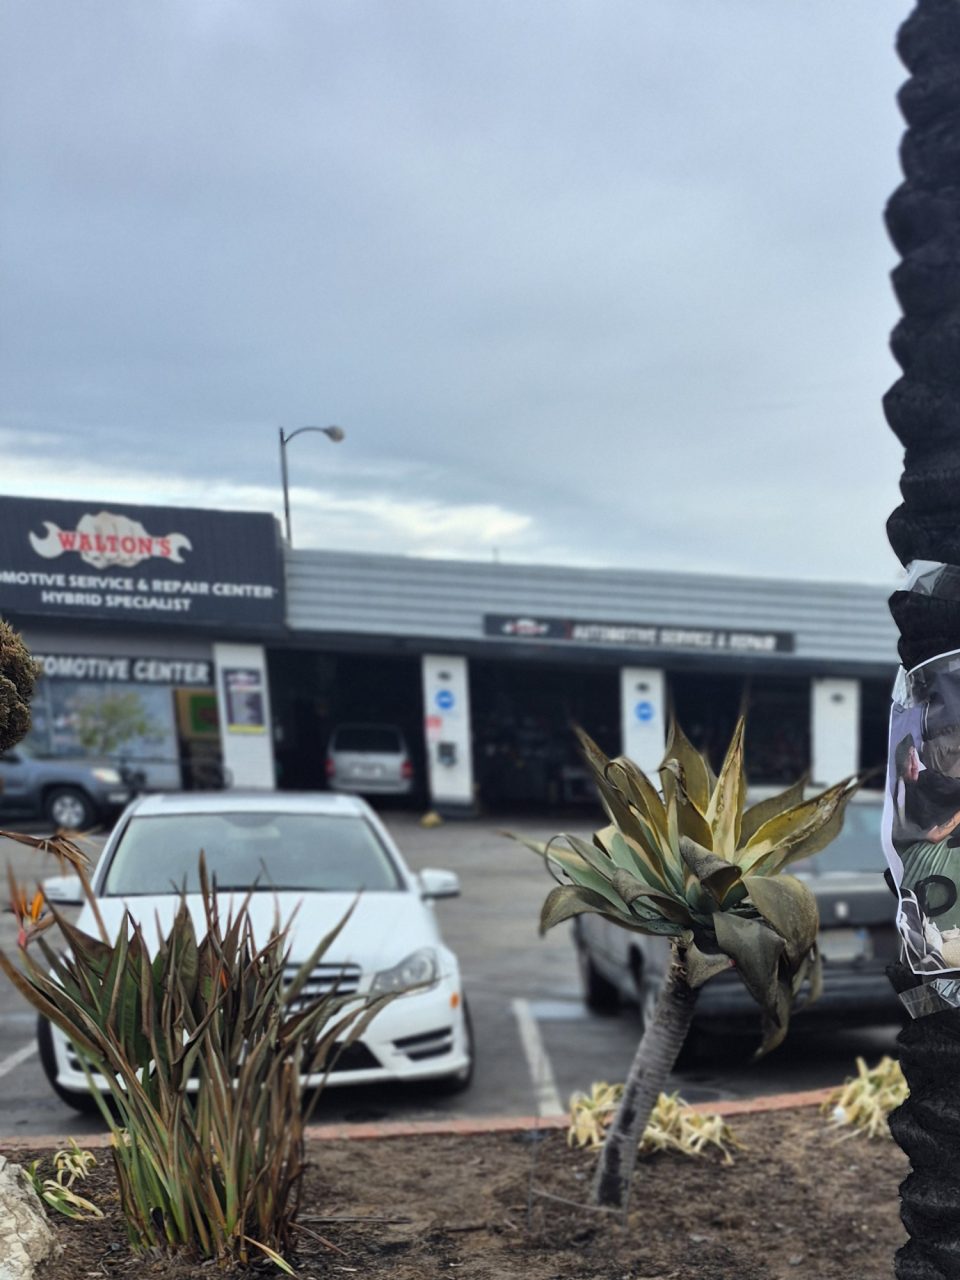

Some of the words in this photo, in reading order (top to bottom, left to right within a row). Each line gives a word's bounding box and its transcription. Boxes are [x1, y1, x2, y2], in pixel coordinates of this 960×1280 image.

[57, 532, 172, 557] WALTON'S
[68, 574, 134, 590] SERVICE
[137, 578, 149, 591] &
[151, 578, 209, 595] REPAIR
[212, 582, 274, 599] CENTER
[41, 590, 102, 606] HYBRID
[105, 594, 192, 611] SPECIALIST
[133, 660, 210, 683] CENTER
